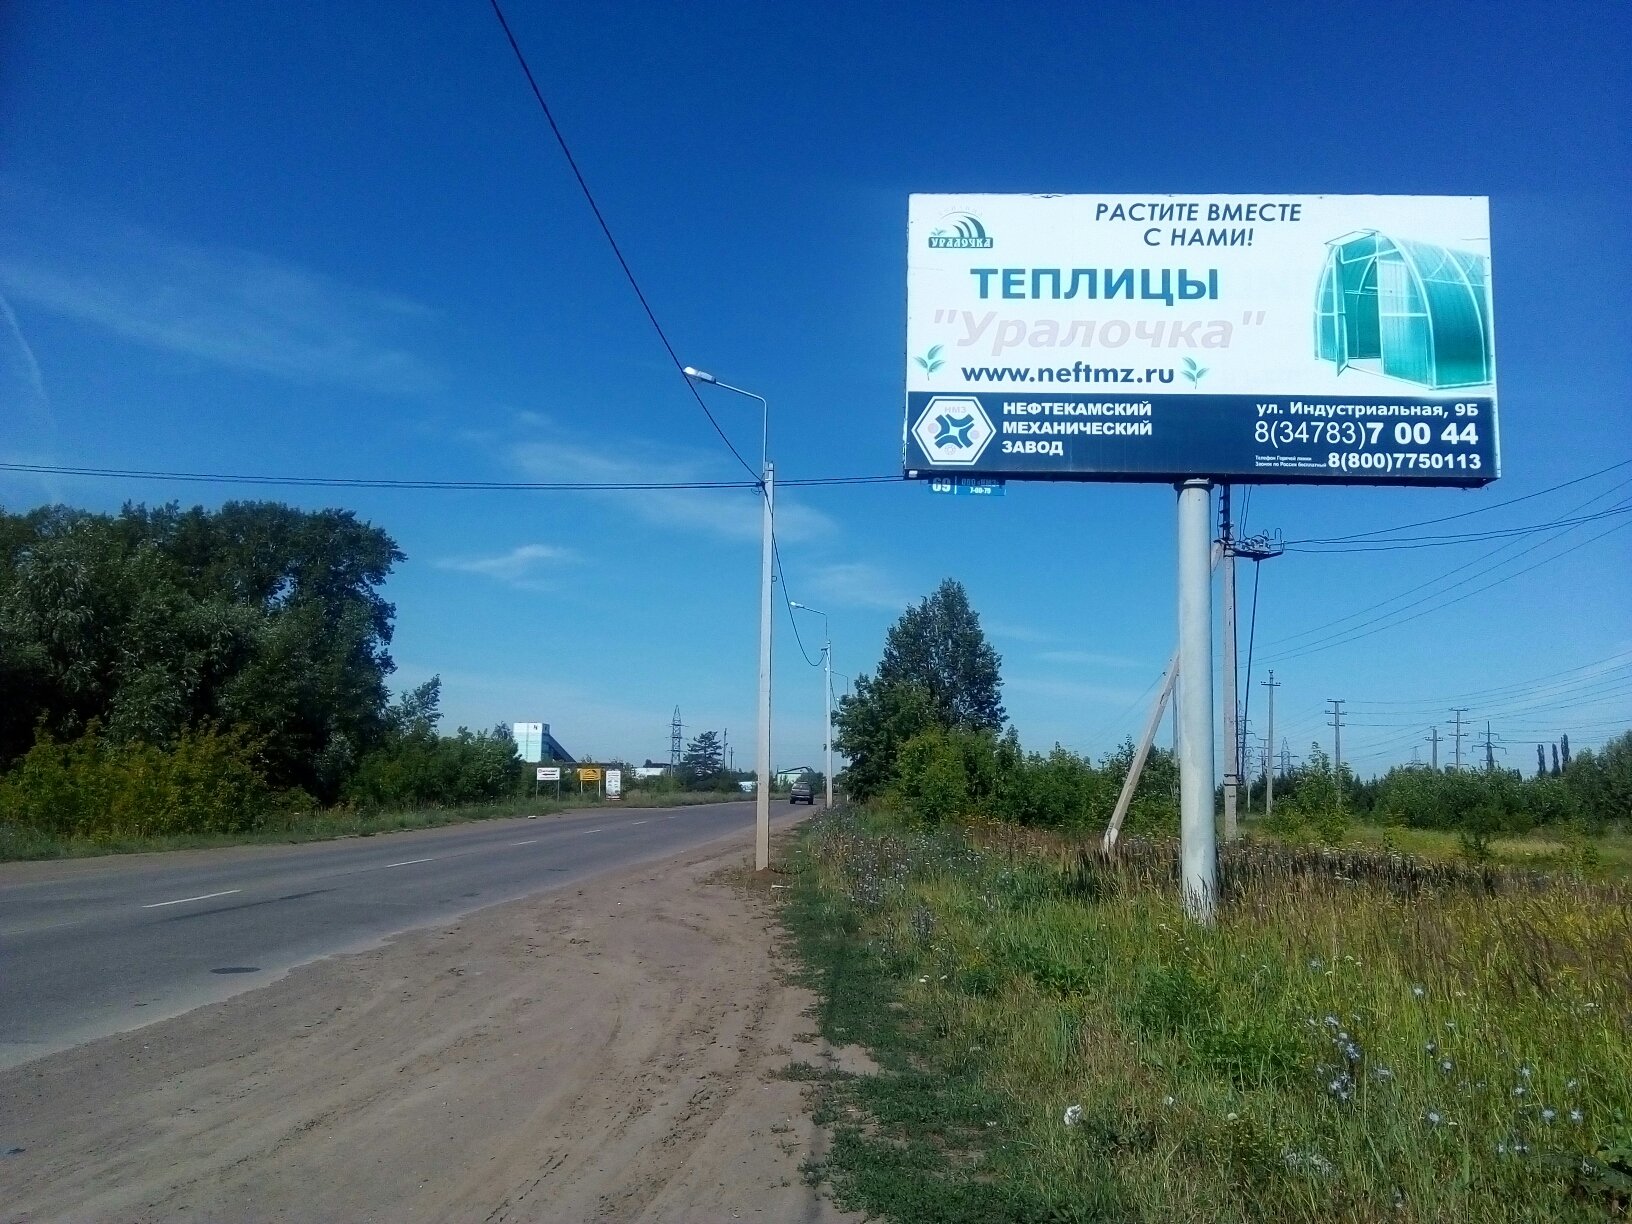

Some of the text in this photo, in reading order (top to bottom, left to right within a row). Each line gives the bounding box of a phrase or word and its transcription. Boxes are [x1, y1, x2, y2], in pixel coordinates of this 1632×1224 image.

[1095, 203, 1302, 222] РАСТИТЕ ВМЕСТЕ
[930, 238, 992, 248] УРАЛОЧКА
[1143, 228, 1254, 247] С НАМИ!
[970, 268, 1219, 306] ТЕПЛИЦЫ
[933, 309, 1266, 356] "Уралочка"
[961, 361, 1175, 383] www.neftmz.ru
[944, 406, 967, 414] НМЗ
[1003, 400, 1152, 416] НЕФТЕКАМСКИЙ
[1256, 402, 1479, 418] ул. Индустриальная, 9Б
[1002, 420, 1153, 436] МЕХАНИЧЕСКИЙ
[1394, 422, 1431, 445] 00
[1440, 422, 1479, 445] 44
[1001, 440, 1064, 456] ЗАВОД
[1328, 452, 1482, 472] 8(800)7750113
